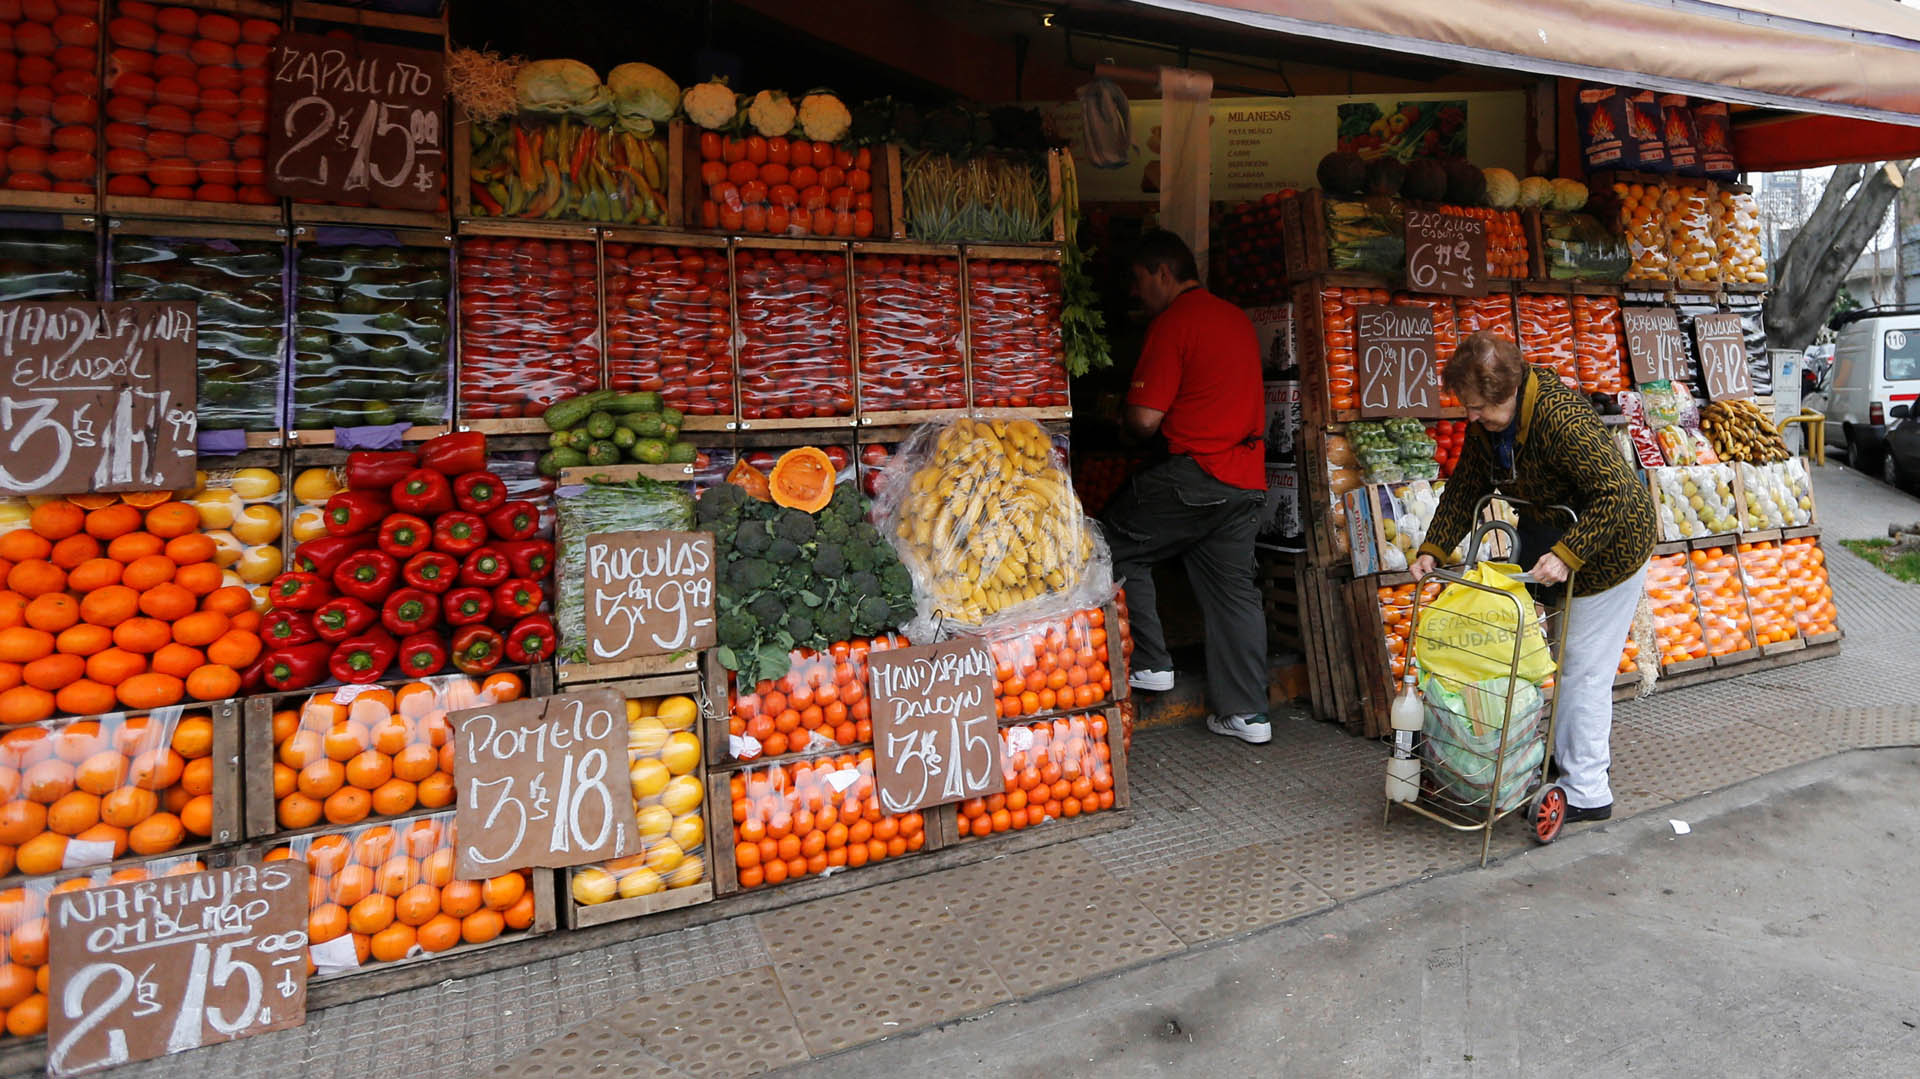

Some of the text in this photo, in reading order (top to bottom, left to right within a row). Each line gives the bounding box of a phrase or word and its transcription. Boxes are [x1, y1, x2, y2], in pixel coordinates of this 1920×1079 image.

[275, 96, 336, 186] 2
[1228, 110, 1292, 122] MILANESAS
[1887, 334, 1905, 346] 110
[1362, 346, 1389, 408] 2
[1397, 347, 1428, 409] 12
[0, 396, 72, 492] 3
[589, 537, 711, 585] RUCULAS
[593, 588, 636, 658] 3
[1426, 602, 1535, 633] ESTACIONS
[871, 647, 992, 700] MANDARINA
[881, 729, 929, 813] 3
[941, 715, 992, 800] 15
[468, 776, 527, 864] 3
[60, 865, 291, 928] NARANJAS
[48, 962, 129, 1076] 2
